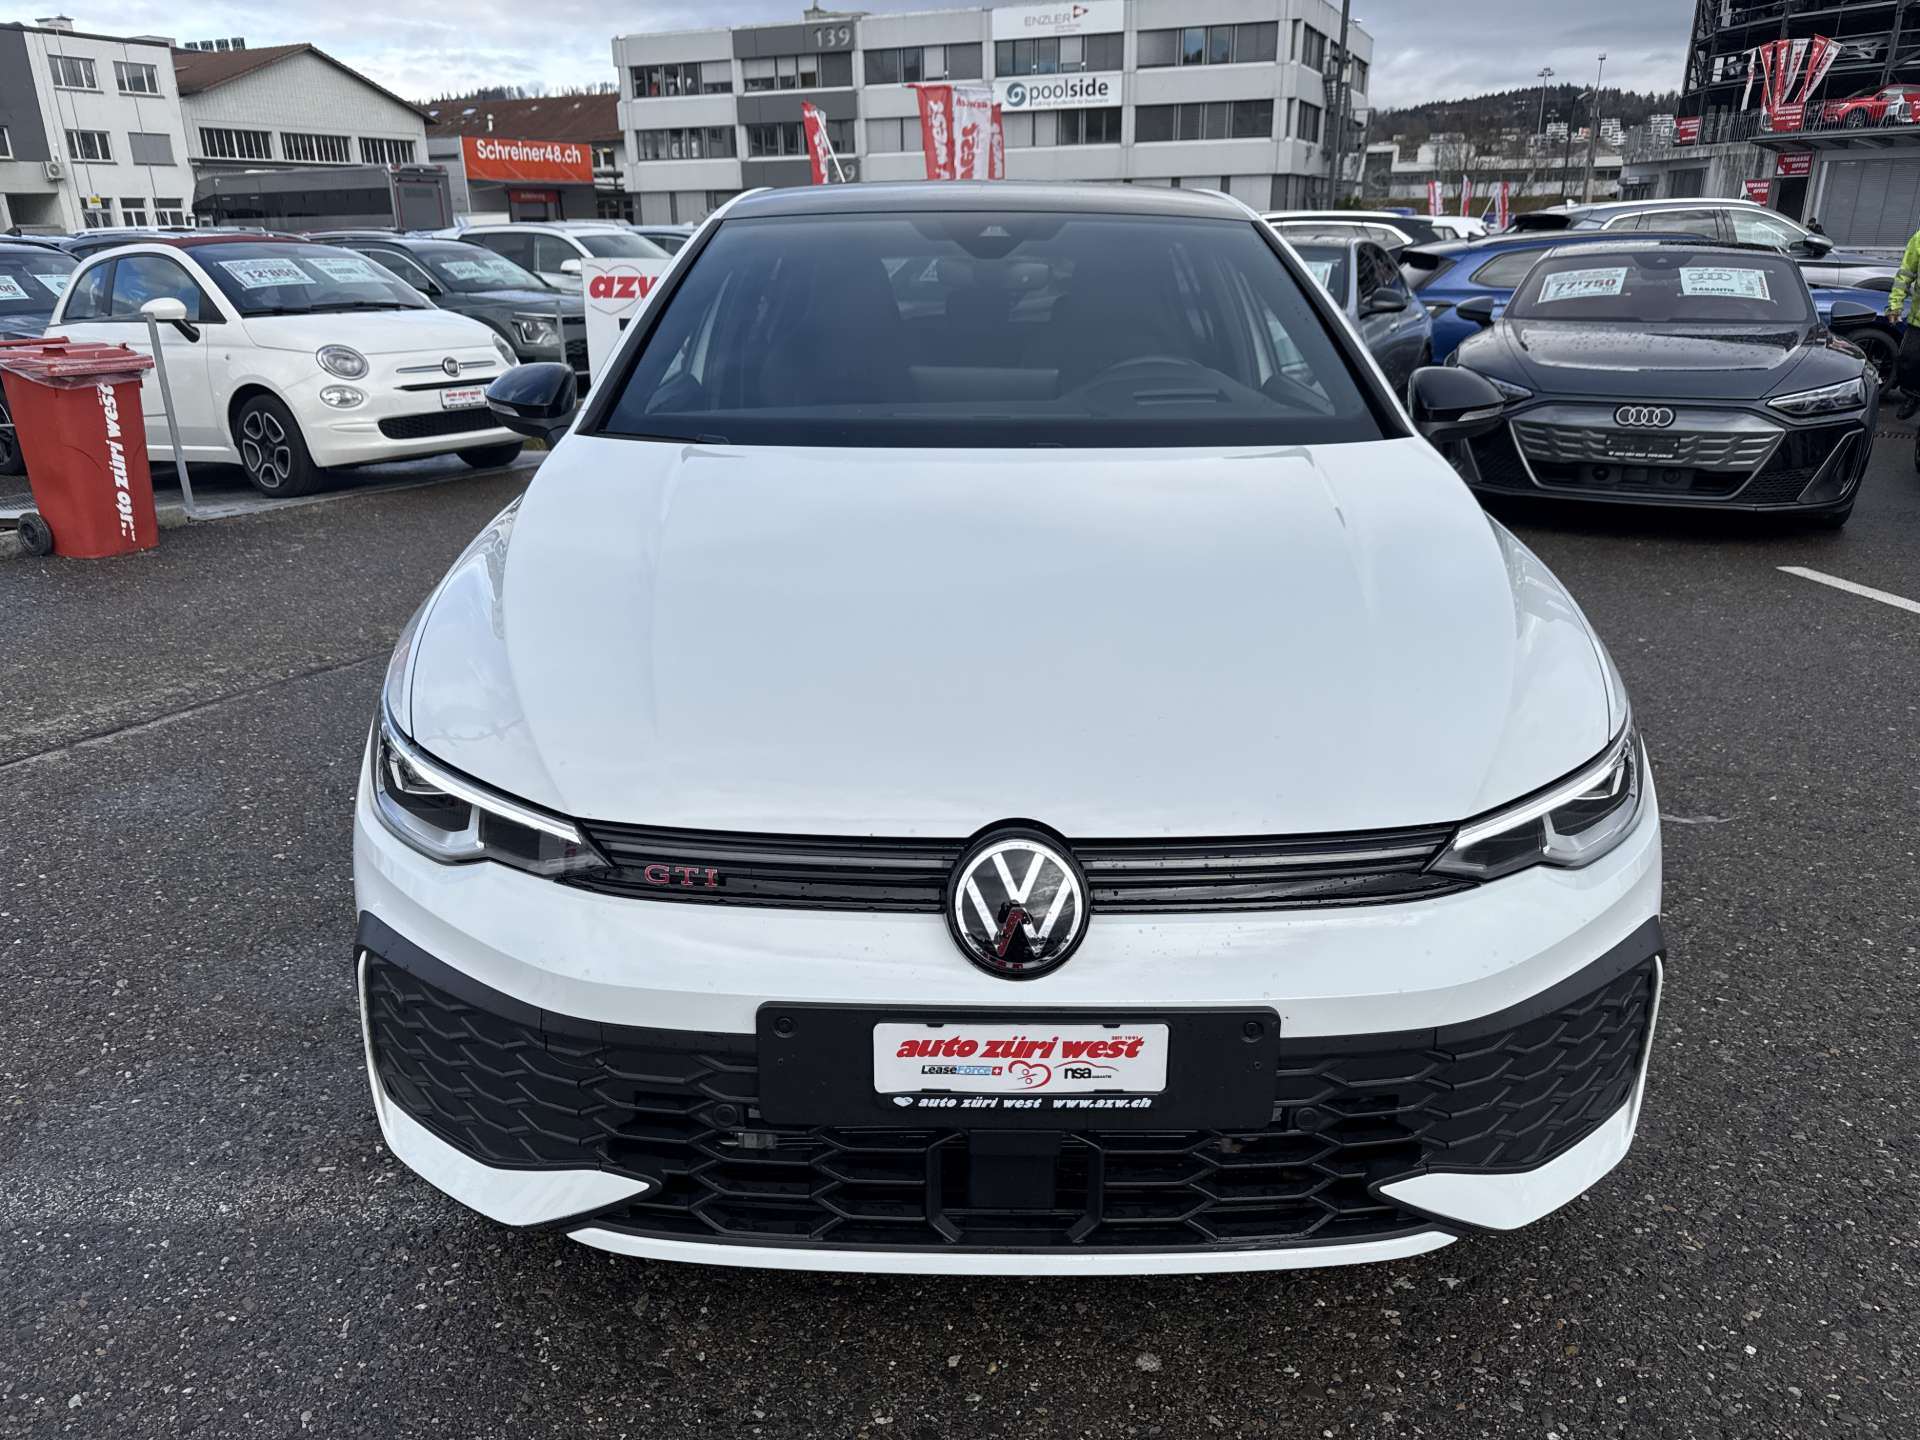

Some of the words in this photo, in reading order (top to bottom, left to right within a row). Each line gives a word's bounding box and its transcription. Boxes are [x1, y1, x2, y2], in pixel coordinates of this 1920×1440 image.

[1024, 14, 1071, 27] ENZLER
[815, 27, 850, 47] 139
[1029, 78, 1109, 106] poolside
[476, 139, 582, 164] Schreiner48.ch
[105, 438, 129, 490] züri
[644, 864, 718, 888] GTI
[897, 1035, 979, 1059] auto
[979, 1036, 1060, 1059] züri
[1062, 1035, 1145, 1059] west
[921, 1065, 992, 1075] LeaseForce
[1064, 1067, 1091, 1079] nsa
[918, 1098, 956, 1109] auto
[961, 1097, 998, 1109] züri
[1003, 1098, 1041, 1109] west
[1052, 1097, 1153, 1109] www.azw.ch
